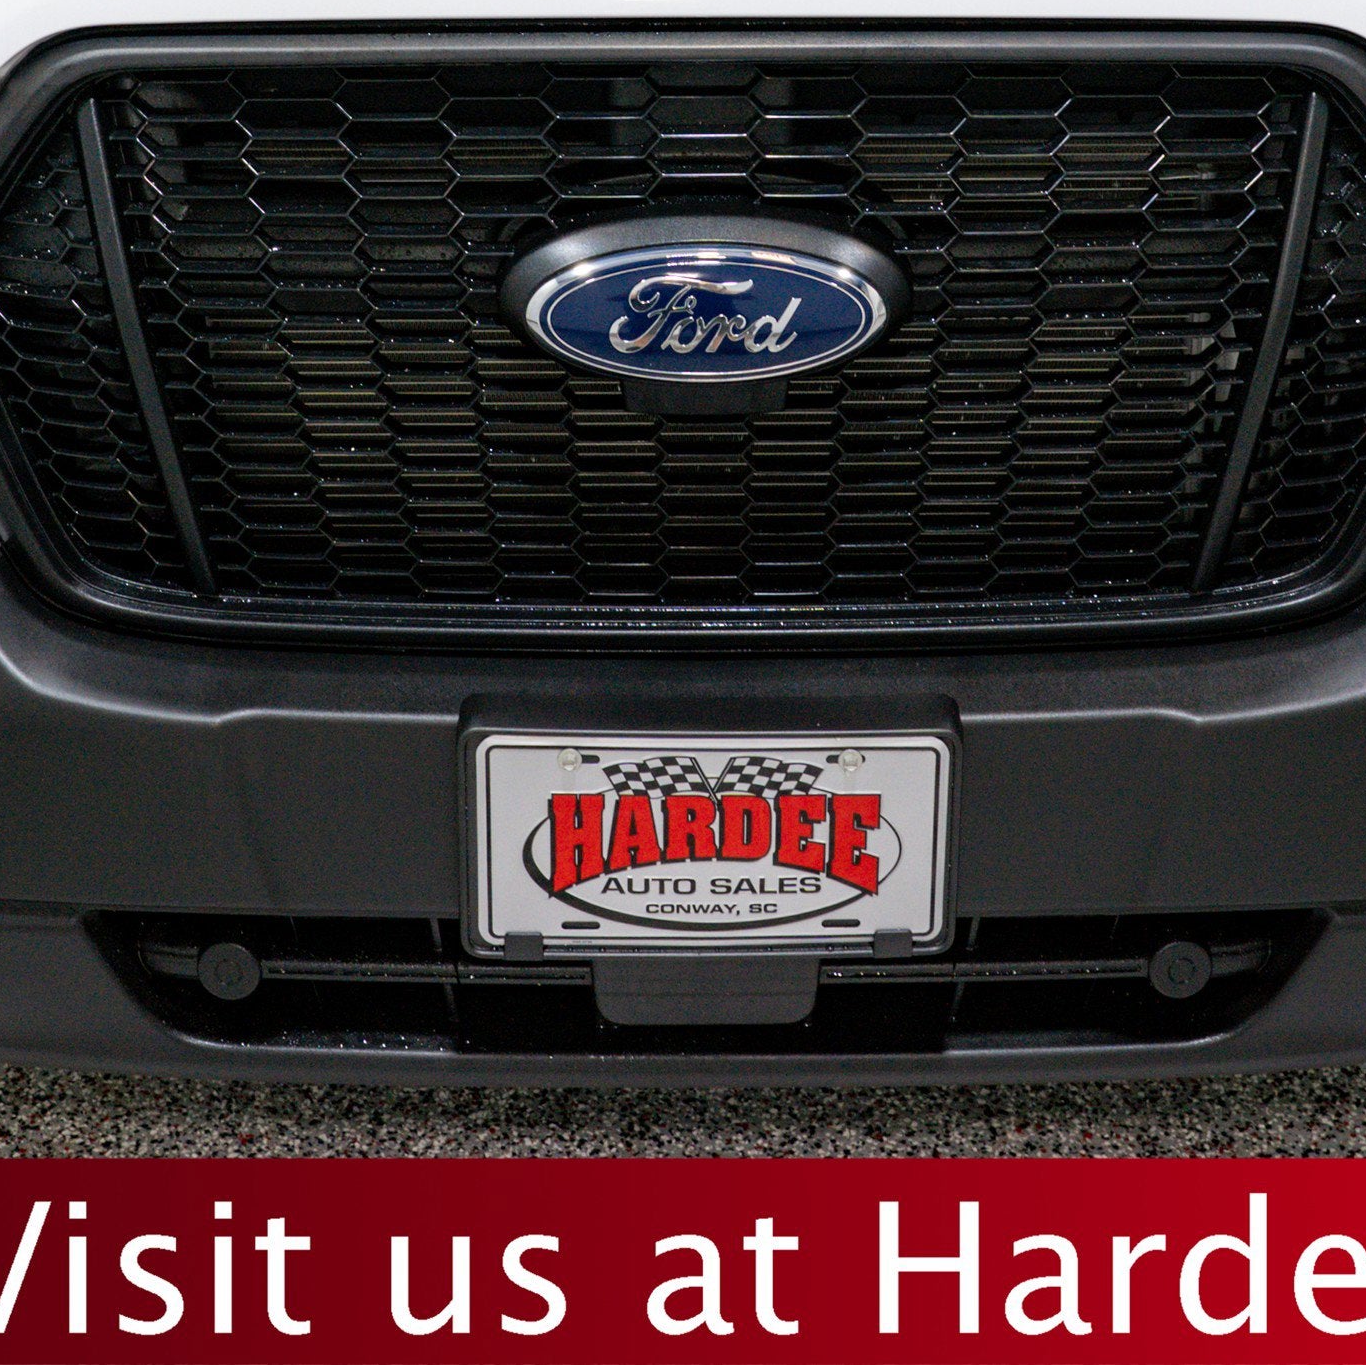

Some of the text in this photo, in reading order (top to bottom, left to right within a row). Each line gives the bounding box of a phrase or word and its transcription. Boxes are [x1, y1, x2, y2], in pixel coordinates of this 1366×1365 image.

[608, 274, 803, 355] Ford
[546, 792, 883, 898] HARDEE
[601, 875, 822, 896] AUTO SALES
[645, 902, 779, 917] CONWAY, SC
